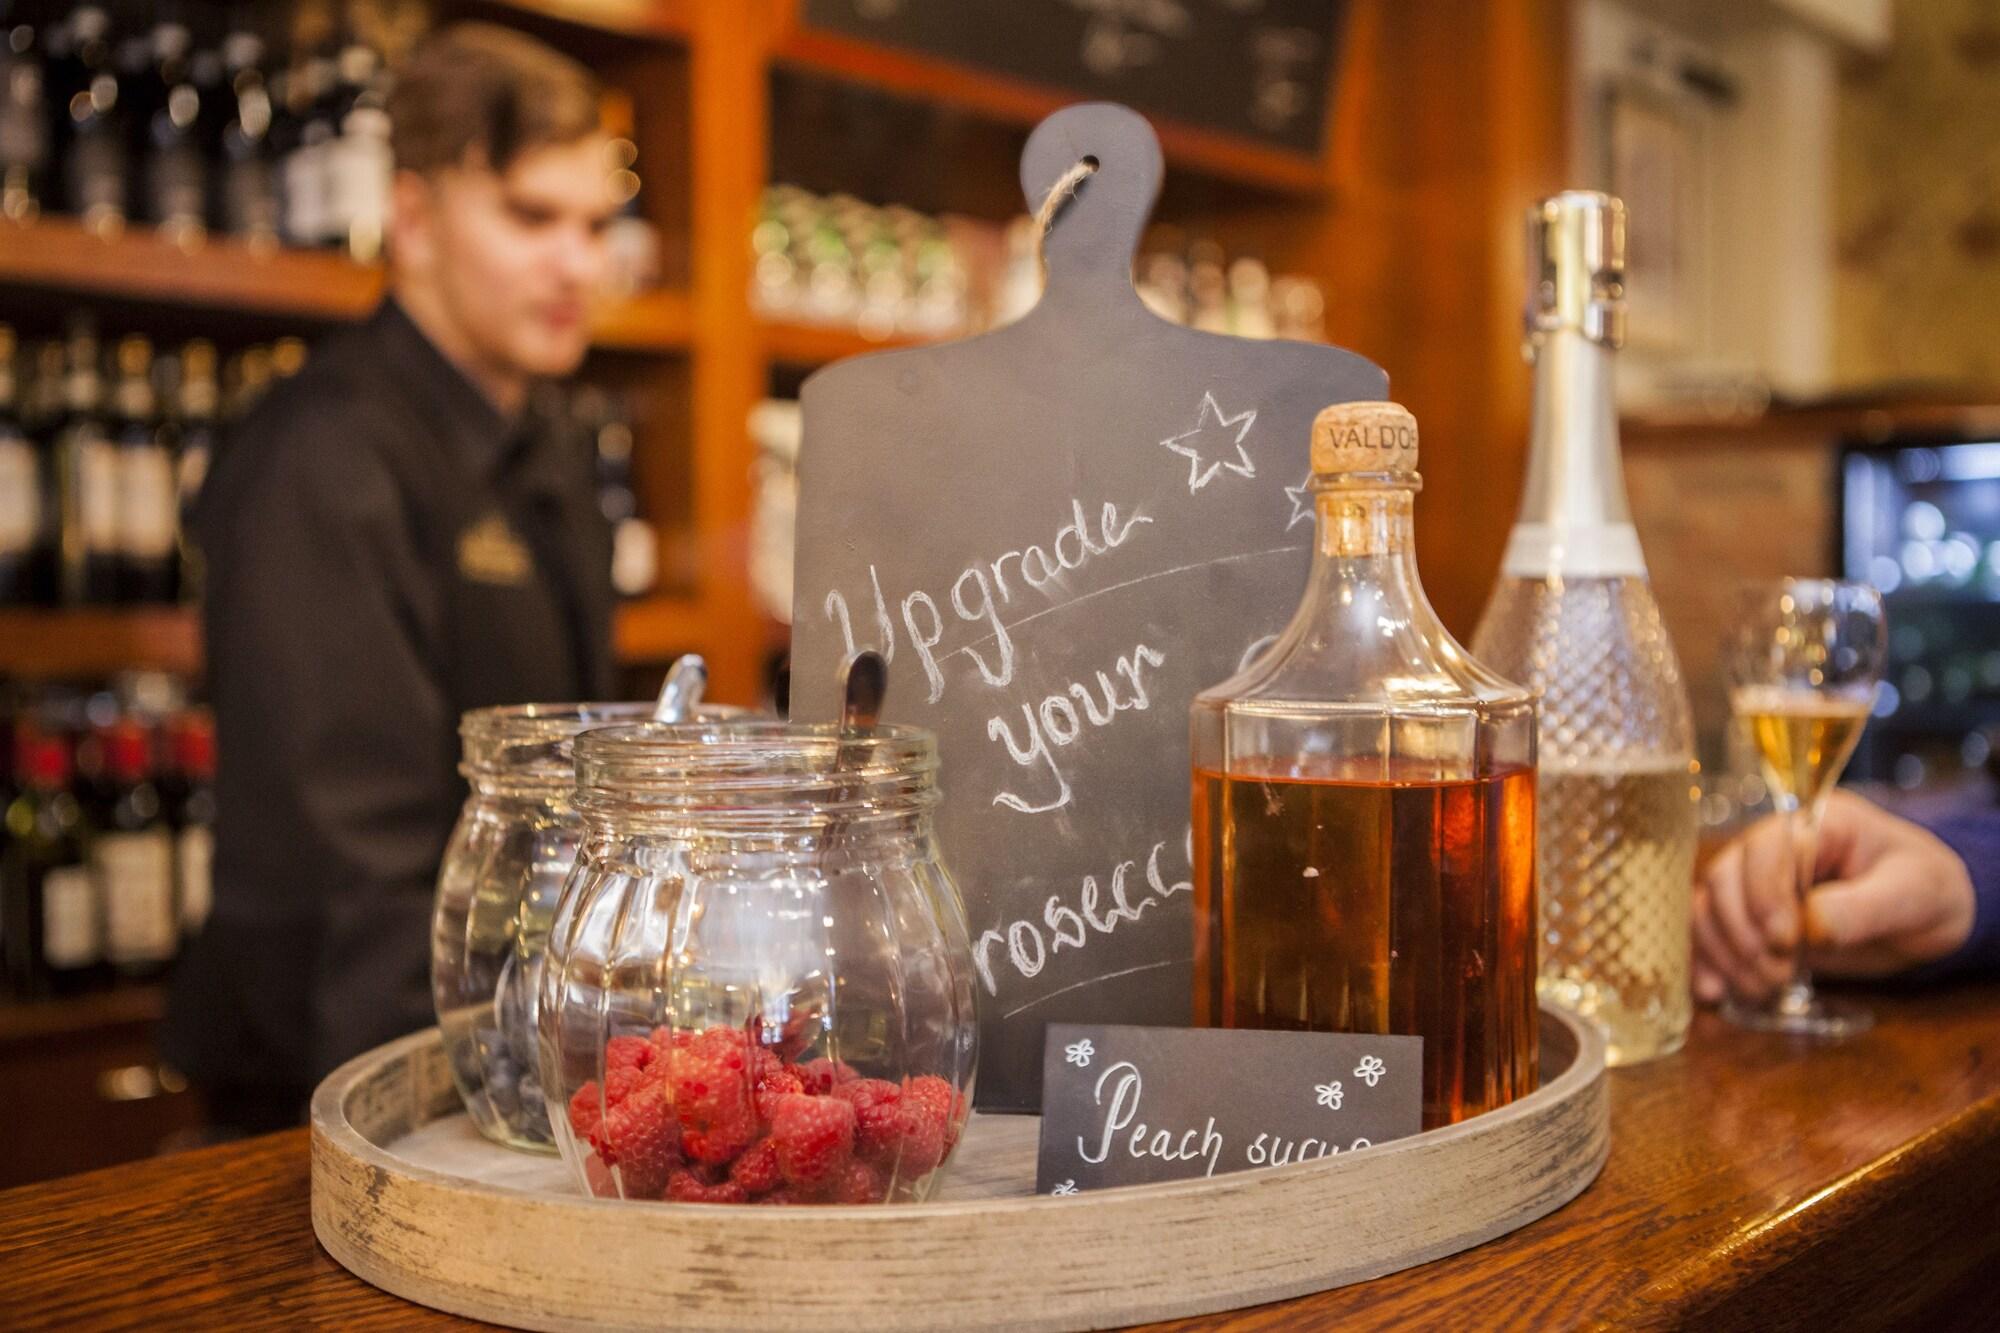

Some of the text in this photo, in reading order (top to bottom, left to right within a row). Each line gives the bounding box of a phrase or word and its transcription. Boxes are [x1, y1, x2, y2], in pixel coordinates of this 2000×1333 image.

[824, 498, 1154, 704] Upgrade
[988, 644, 1166, 814] your
[972, 822, 1194, 997] rosecc
[1078, 1061, 1223, 1178] Peach
